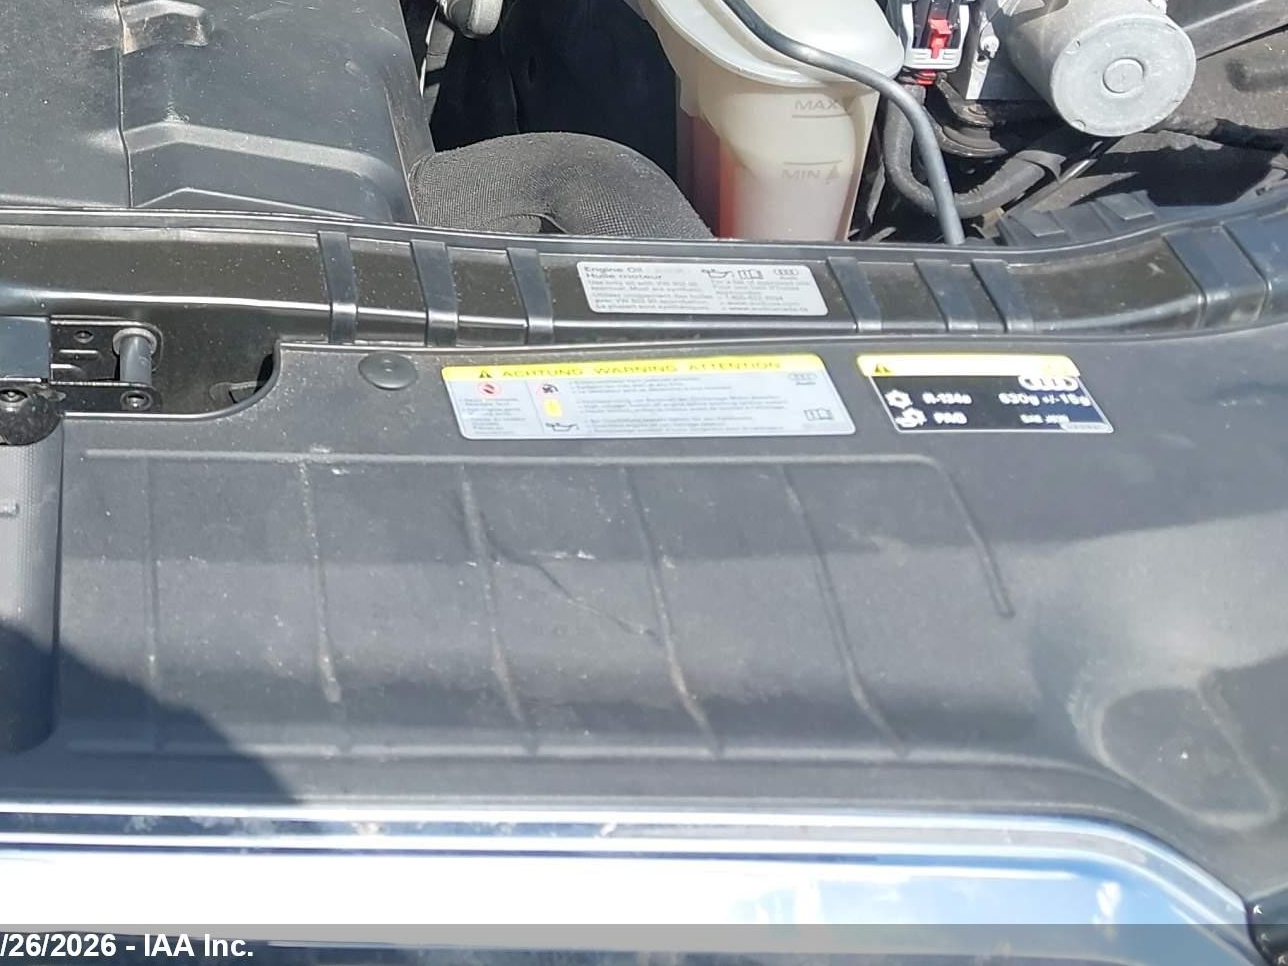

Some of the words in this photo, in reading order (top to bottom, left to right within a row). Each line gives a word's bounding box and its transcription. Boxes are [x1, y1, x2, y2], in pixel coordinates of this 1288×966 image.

[795, 99, 840, 111] MAX
[782, 169, 821, 179] MIN
[502, 369, 584, 377] ACHTUNG
[593, 365, 678, 375] WARNING
[689, 361, 781, 370] ATTENTION
